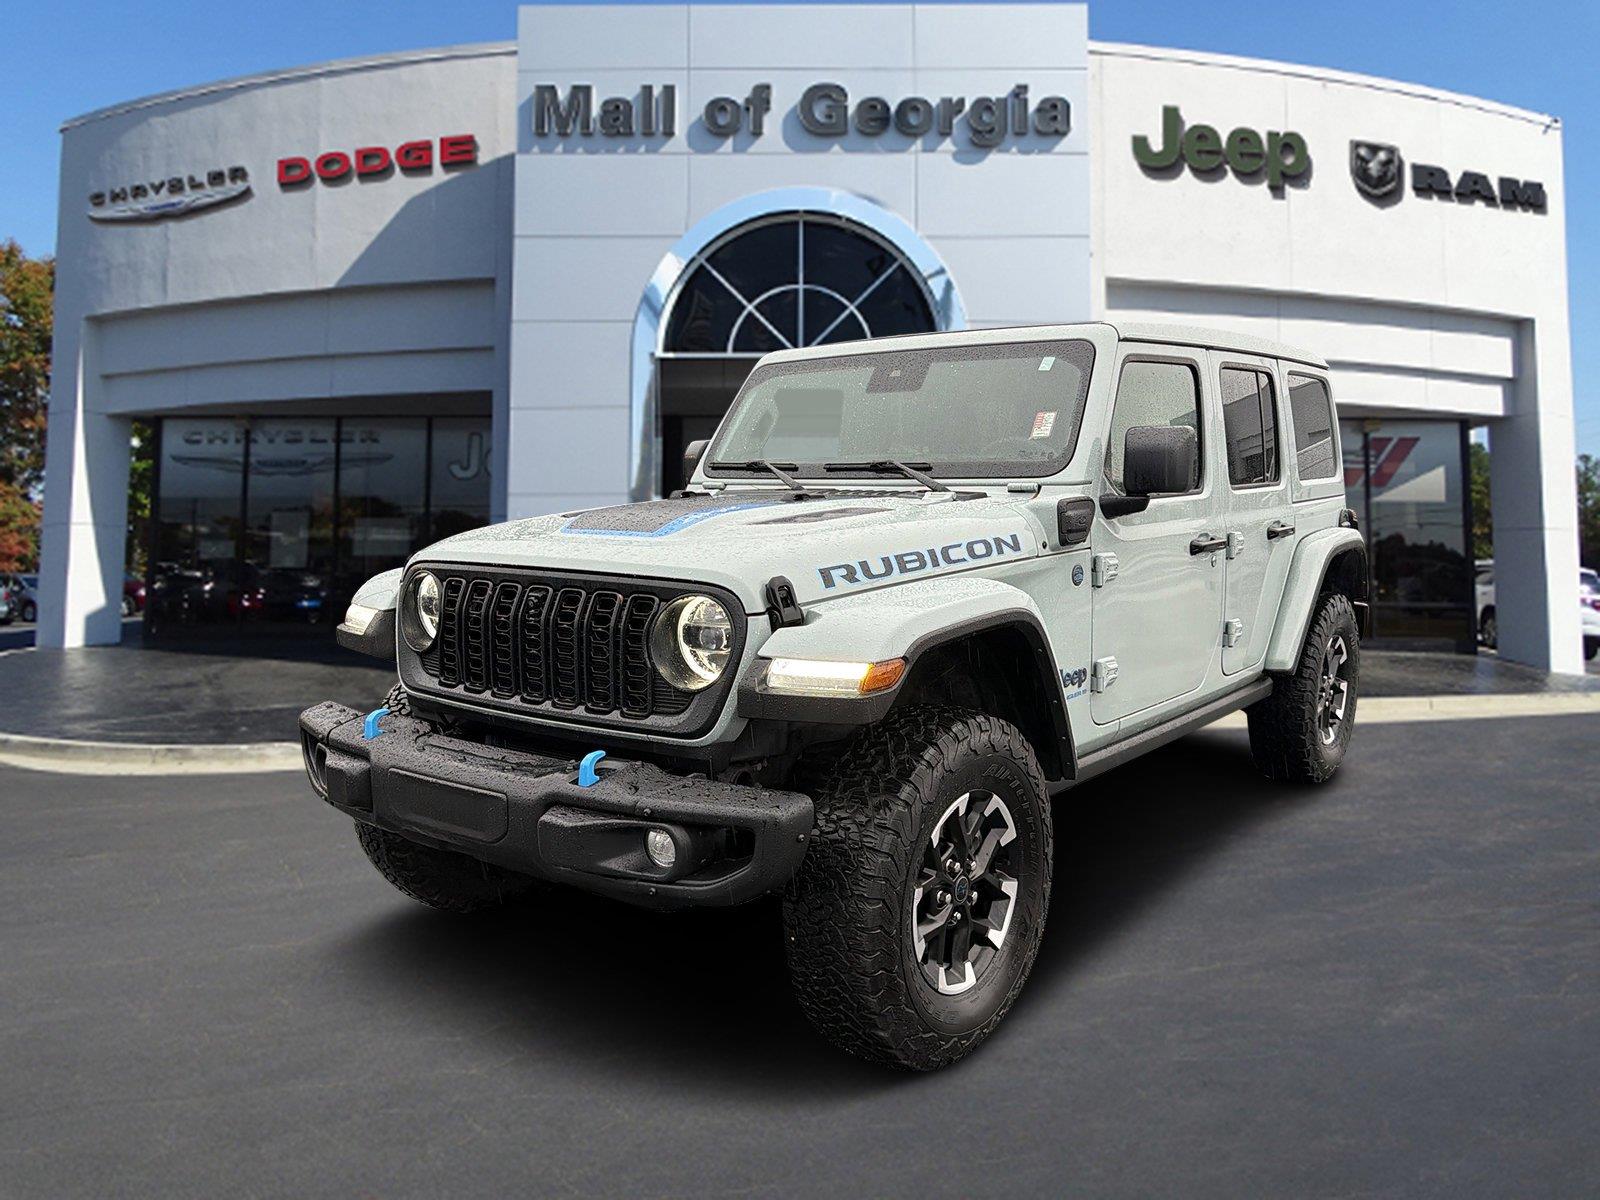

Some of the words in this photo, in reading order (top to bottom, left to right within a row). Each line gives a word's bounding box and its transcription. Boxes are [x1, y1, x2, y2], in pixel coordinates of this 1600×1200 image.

[532, 84, 676, 138] Mall
[703, 83, 772, 138] of
[799, 82, 1072, 149] Georgia
[277, 134, 477, 191] DODGE
[1131, 104, 1309, 193] Jeep
[88, 165, 249, 206] CHRYSLER
[1411, 162, 1547, 214] RAM
[817, 533, 1022, 589] RUBICON
